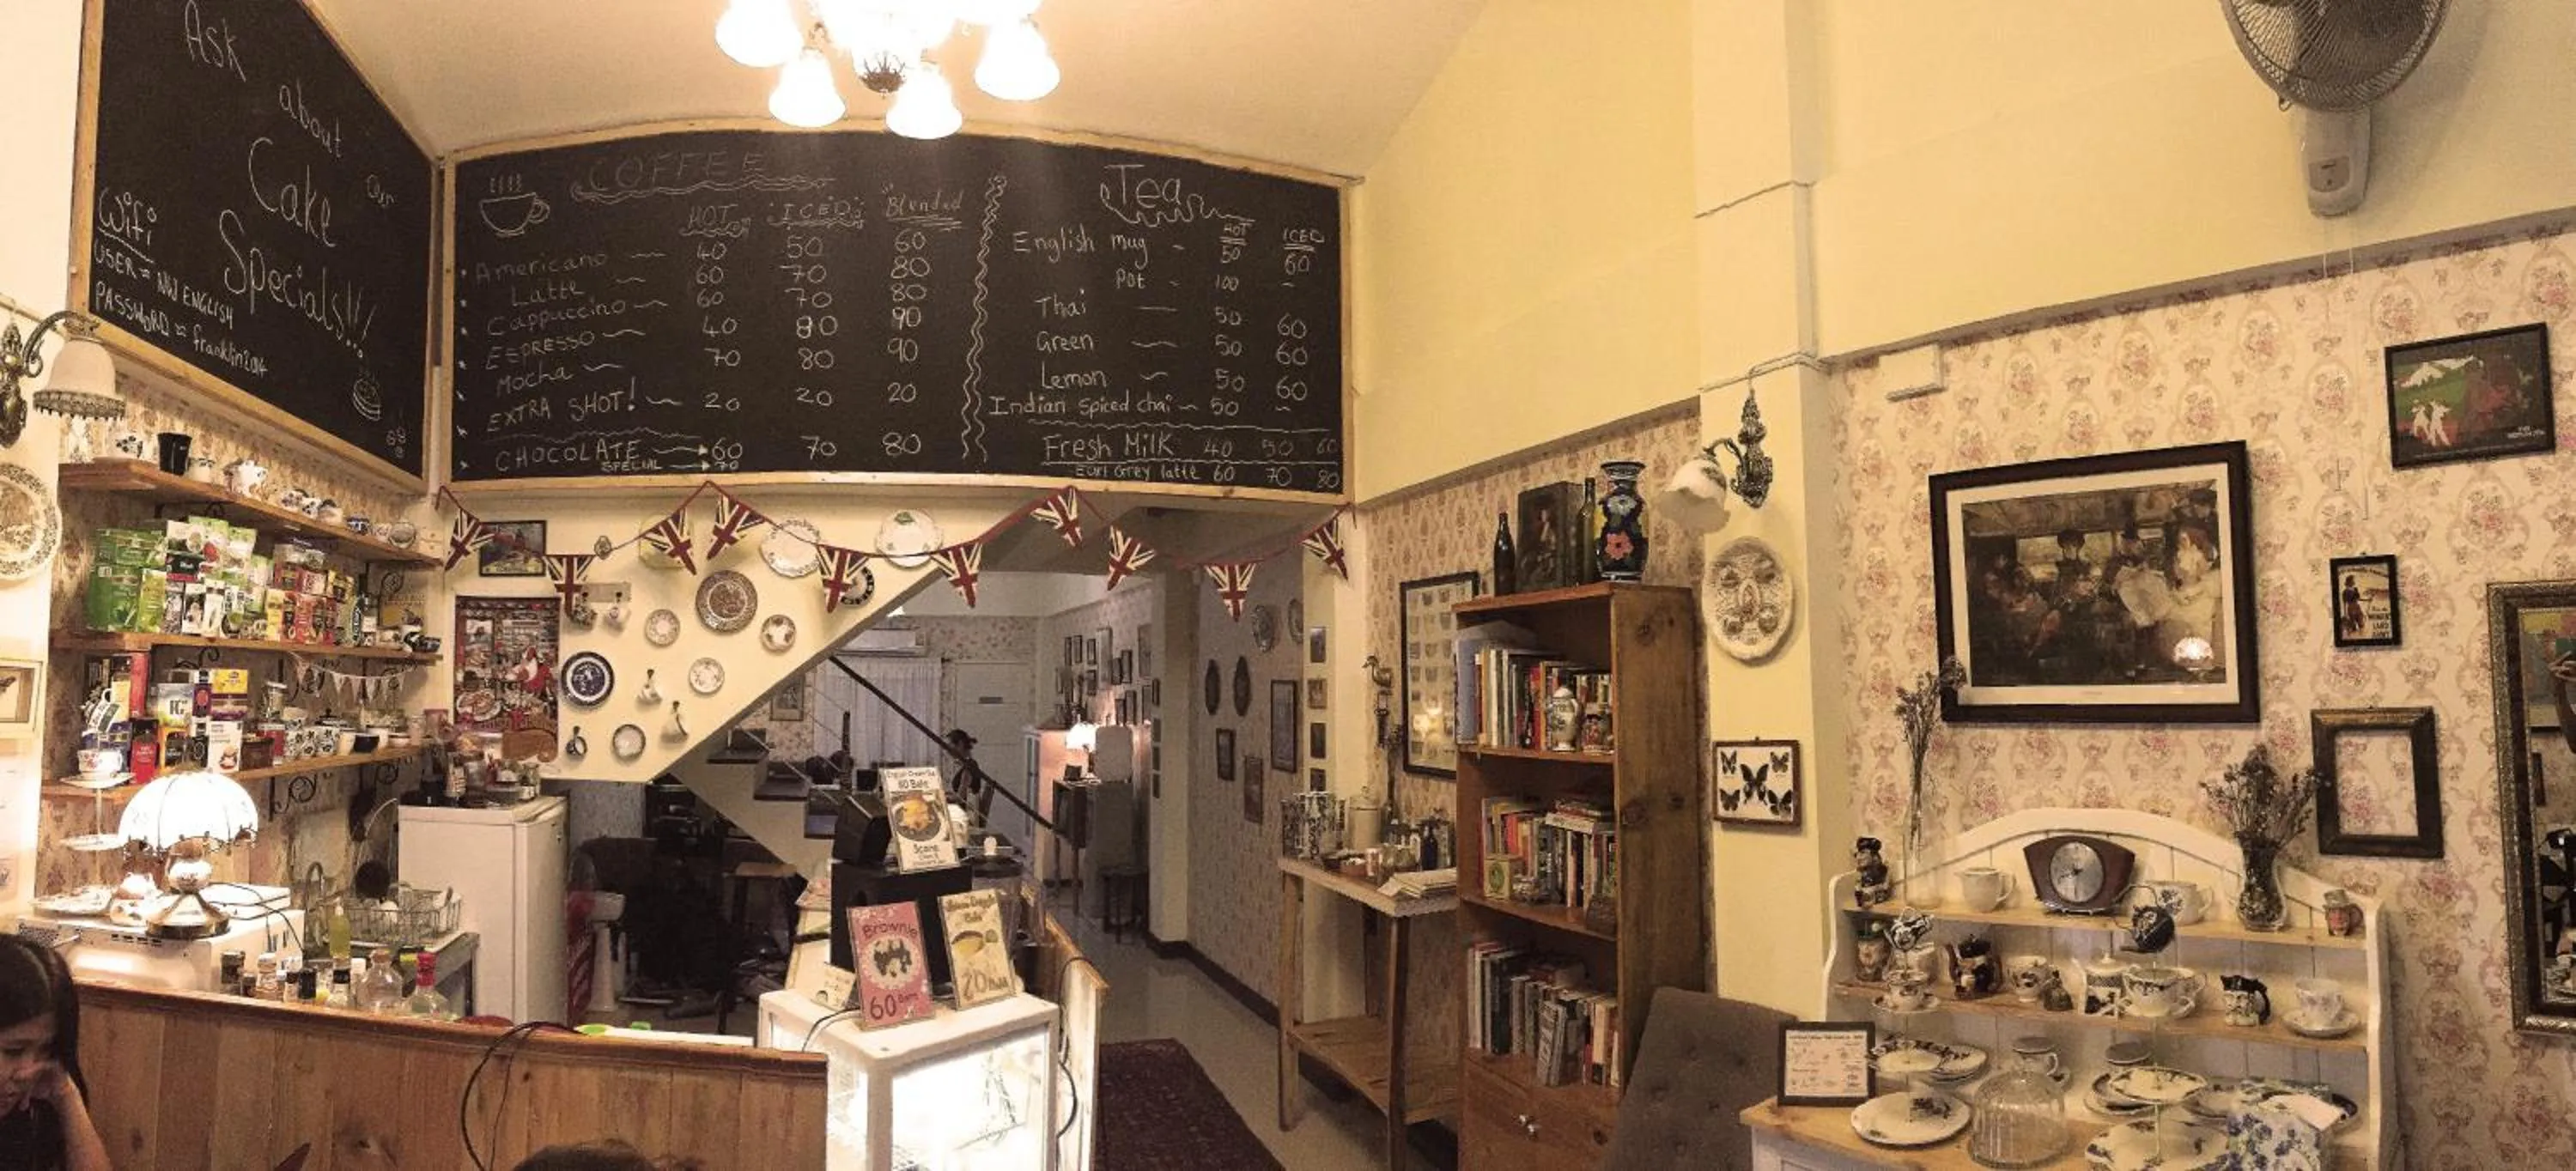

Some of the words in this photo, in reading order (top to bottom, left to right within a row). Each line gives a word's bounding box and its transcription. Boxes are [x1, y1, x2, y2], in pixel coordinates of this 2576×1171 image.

[184, 0, 246, 82] Ask
[278, 80, 345, 159] about
[589, 149, 765, 191] COFFEE
[1104, 164, 1181, 208] Tea
[248, 137, 337, 247] Cake
[688, 203, 738, 228] HOT
[1223, 221, 1253, 237] HOT
[475, 253, 606, 284] Americano
[696, 241, 727, 260] 40
[787, 236, 823, 258] 50
[896, 228, 926, 252] 60
[1012, 223, 1096, 264] English
[1220, 246, 1241, 264] 50
[1285, 252, 1310, 276] 60
[94, 239, 137, 280] USER
[183, 285, 234, 331] ENGLISH
[511, 281, 585, 306] Latte
[696, 265, 724, 284] 60
[780, 264, 827, 284] 70
[890, 256, 930, 279] 80
[1215, 274, 1239, 292] 100
[94, 281, 170, 337] PASSWORD
[487, 297, 626, 336] Cappuccino
[696, 289, 724, 308] 60
[784, 288, 832, 308] 70
[890, 282, 927, 301] 80
[702, 315, 738, 338] 40
[796, 315, 838, 339] 80
[892, 306, 921, 331] 90
[1035, 288, 1087, 319] Thai
[1214, 306, 1242, 326] 50
[1277, 315, 1307, 339] 60
[704, 348, 741, 367] 70
[798, 347, 835, 370] 80
[887, 337, 918, 362] 90
[1036, 330, 1095, 353] Green
[1214, 334, 1243, 356] 50
[1275, 342, 1308, 367] 60
[1040, 361, 1109, 390] Lemon
[1214, 370, 1245, 392] 50
[1276, 378, 1308, 401] 60
[487, 397, 551, 432] EXTRA
[568, 375, 636, 422] SHOT!
[704, 392, 740, 411] 20
[796, 387, 833, 406] 20
[887, 383, 917, 403] 20
[989, 391, 1066, 415] Indian
[1210, 399, 1240, 416] 50
[495, 439, 641, 471] CHOCOLATE
[712, 437, 743, 461] 60
[800, 435, 837, 460] 70
[883, 432, 921, 457] 80
[1042, 433, 1112, 461] Fresh
[1203, 438, 1234, 458] 40
[1262, 438, 1294, 458] 50
[1114, 464, 1151, 482] Grey
[1212, 466, 1236, 482] 60
[1265, 466, 1292, 487] 70
[1317, 469, 1340, 488] 80
[870, 993, 897, 1021] 60
